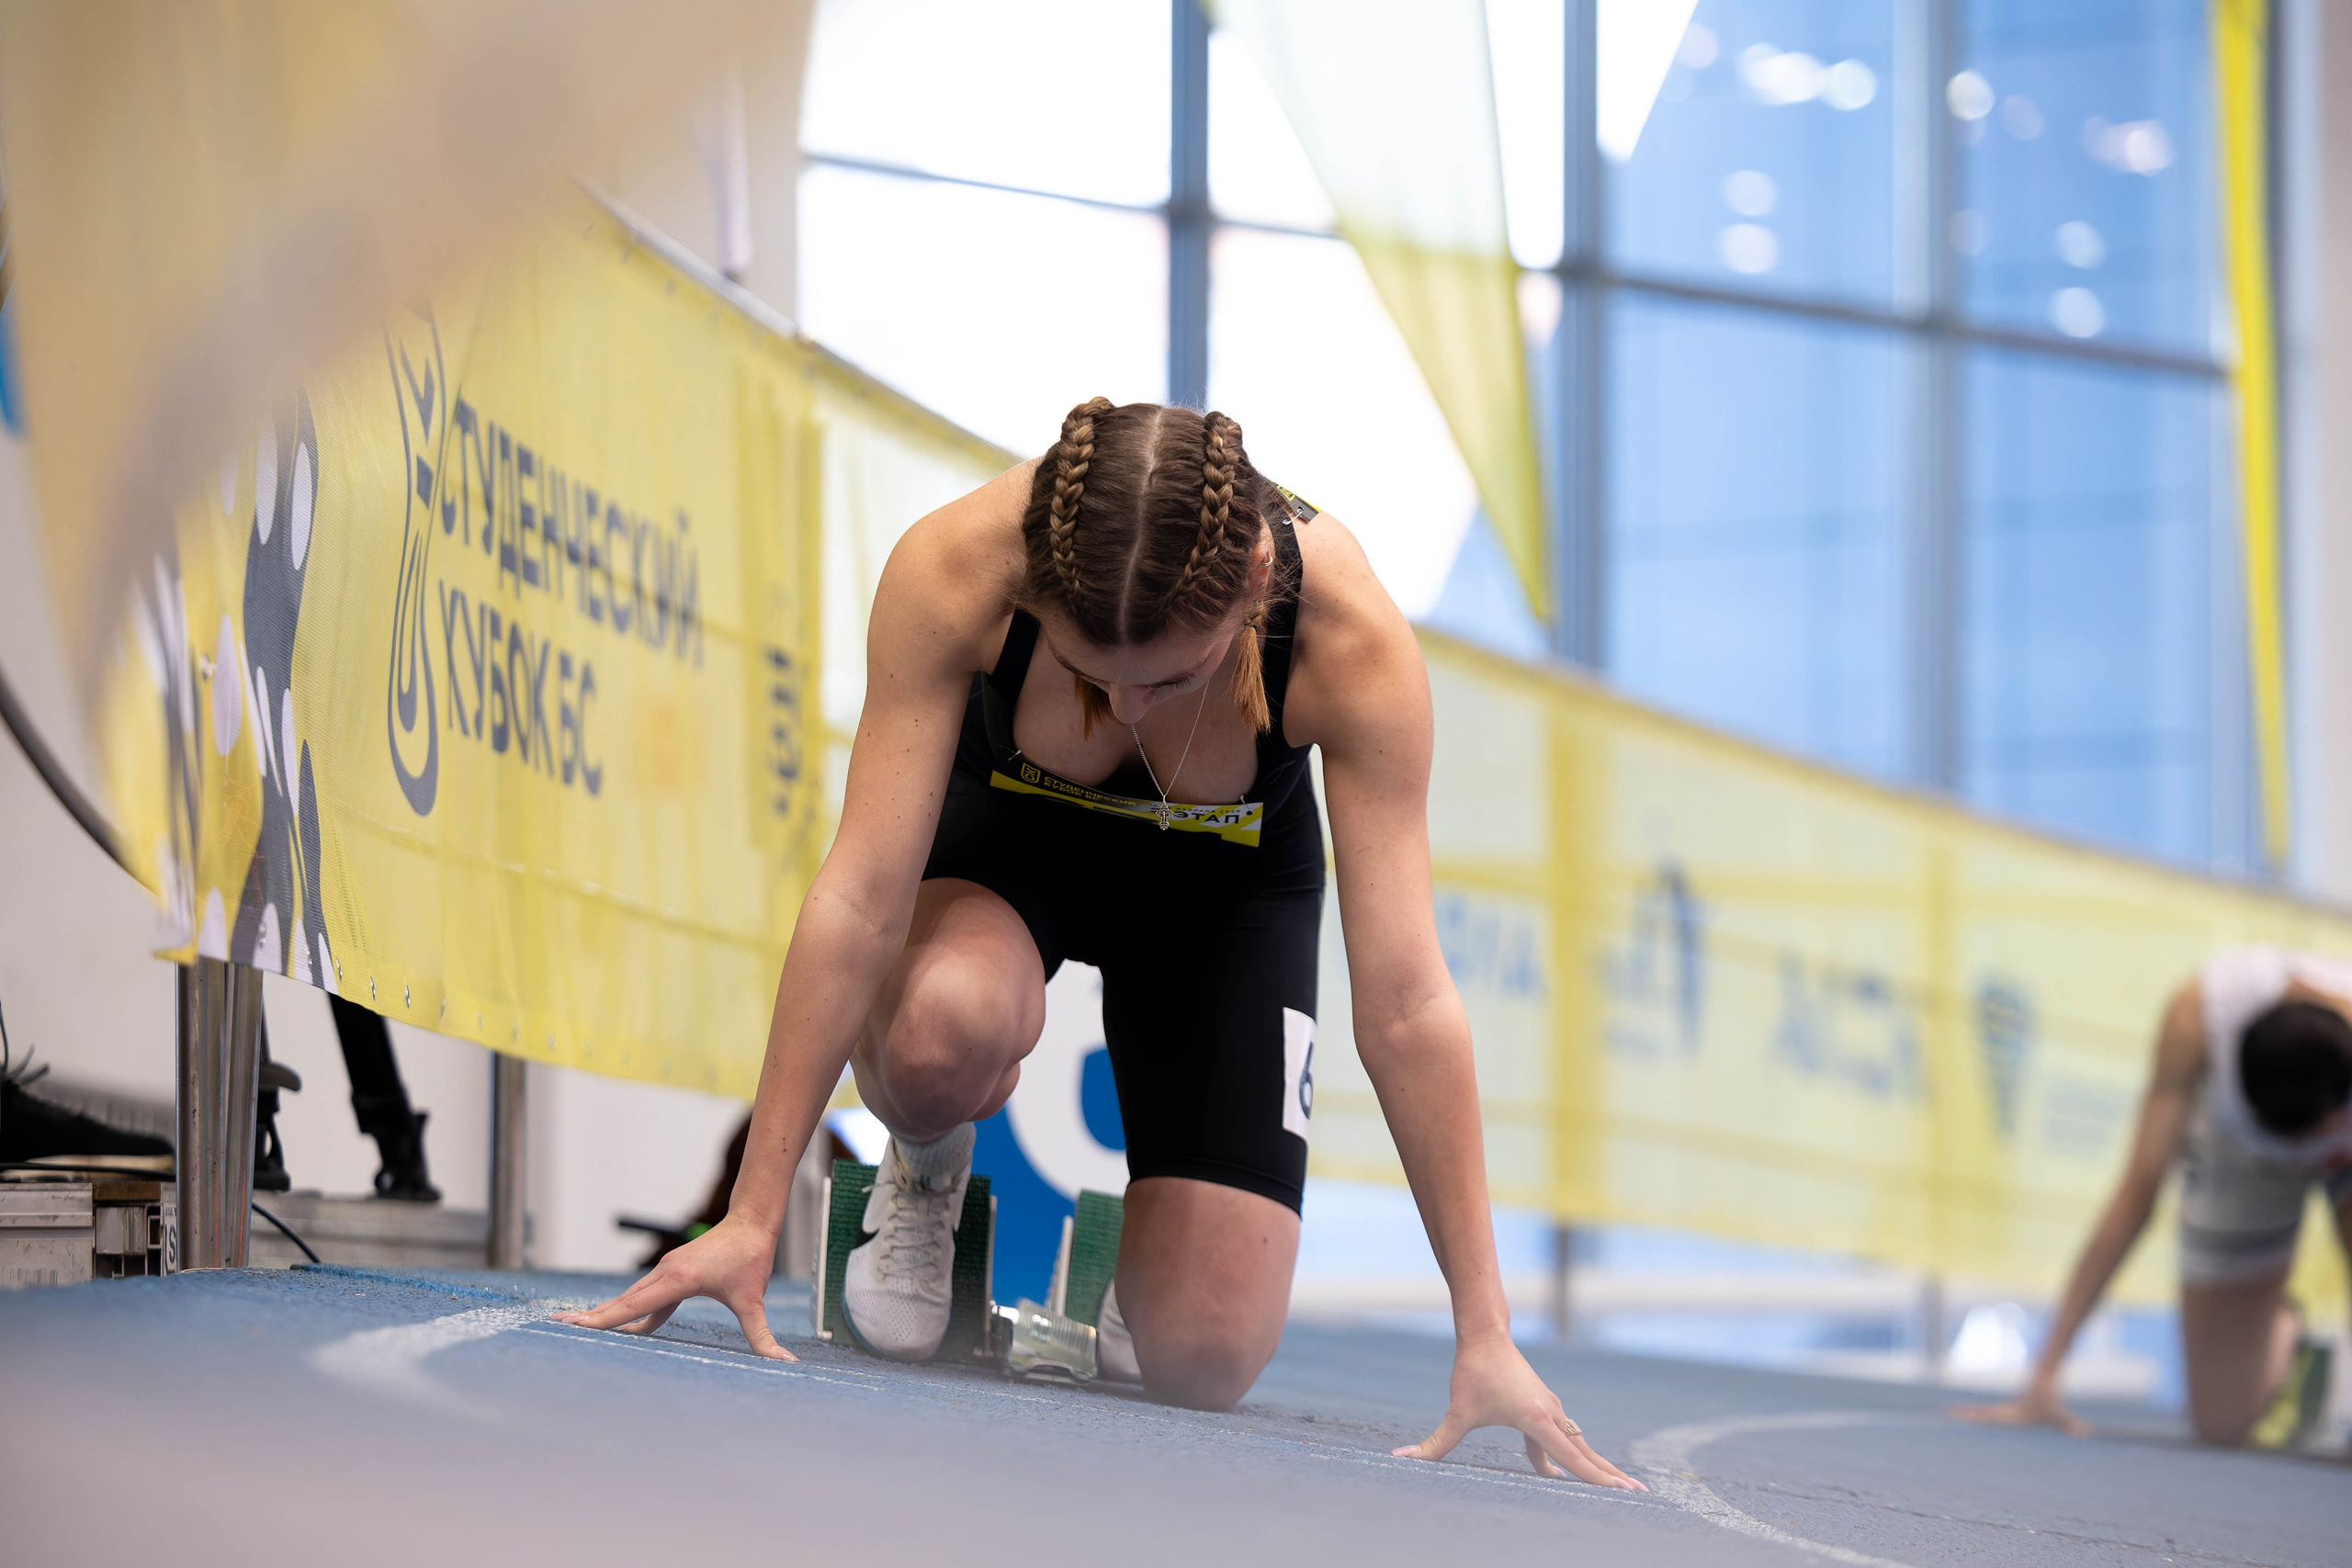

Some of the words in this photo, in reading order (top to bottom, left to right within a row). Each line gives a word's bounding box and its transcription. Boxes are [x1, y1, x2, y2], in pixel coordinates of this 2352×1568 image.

[441, 382, 706, 672] СТУДЕНЧЕСКИЙ
[437, 579, 555, 778] КУБОК
[559, 647, 604, 800] БС
[1044, 781, 1082, 796] КУБОК
[1044, 776, 1137, 807] СТУДЕНЧЕСКИЙ
[1173, 810, 1240, 824] ЭТАП
